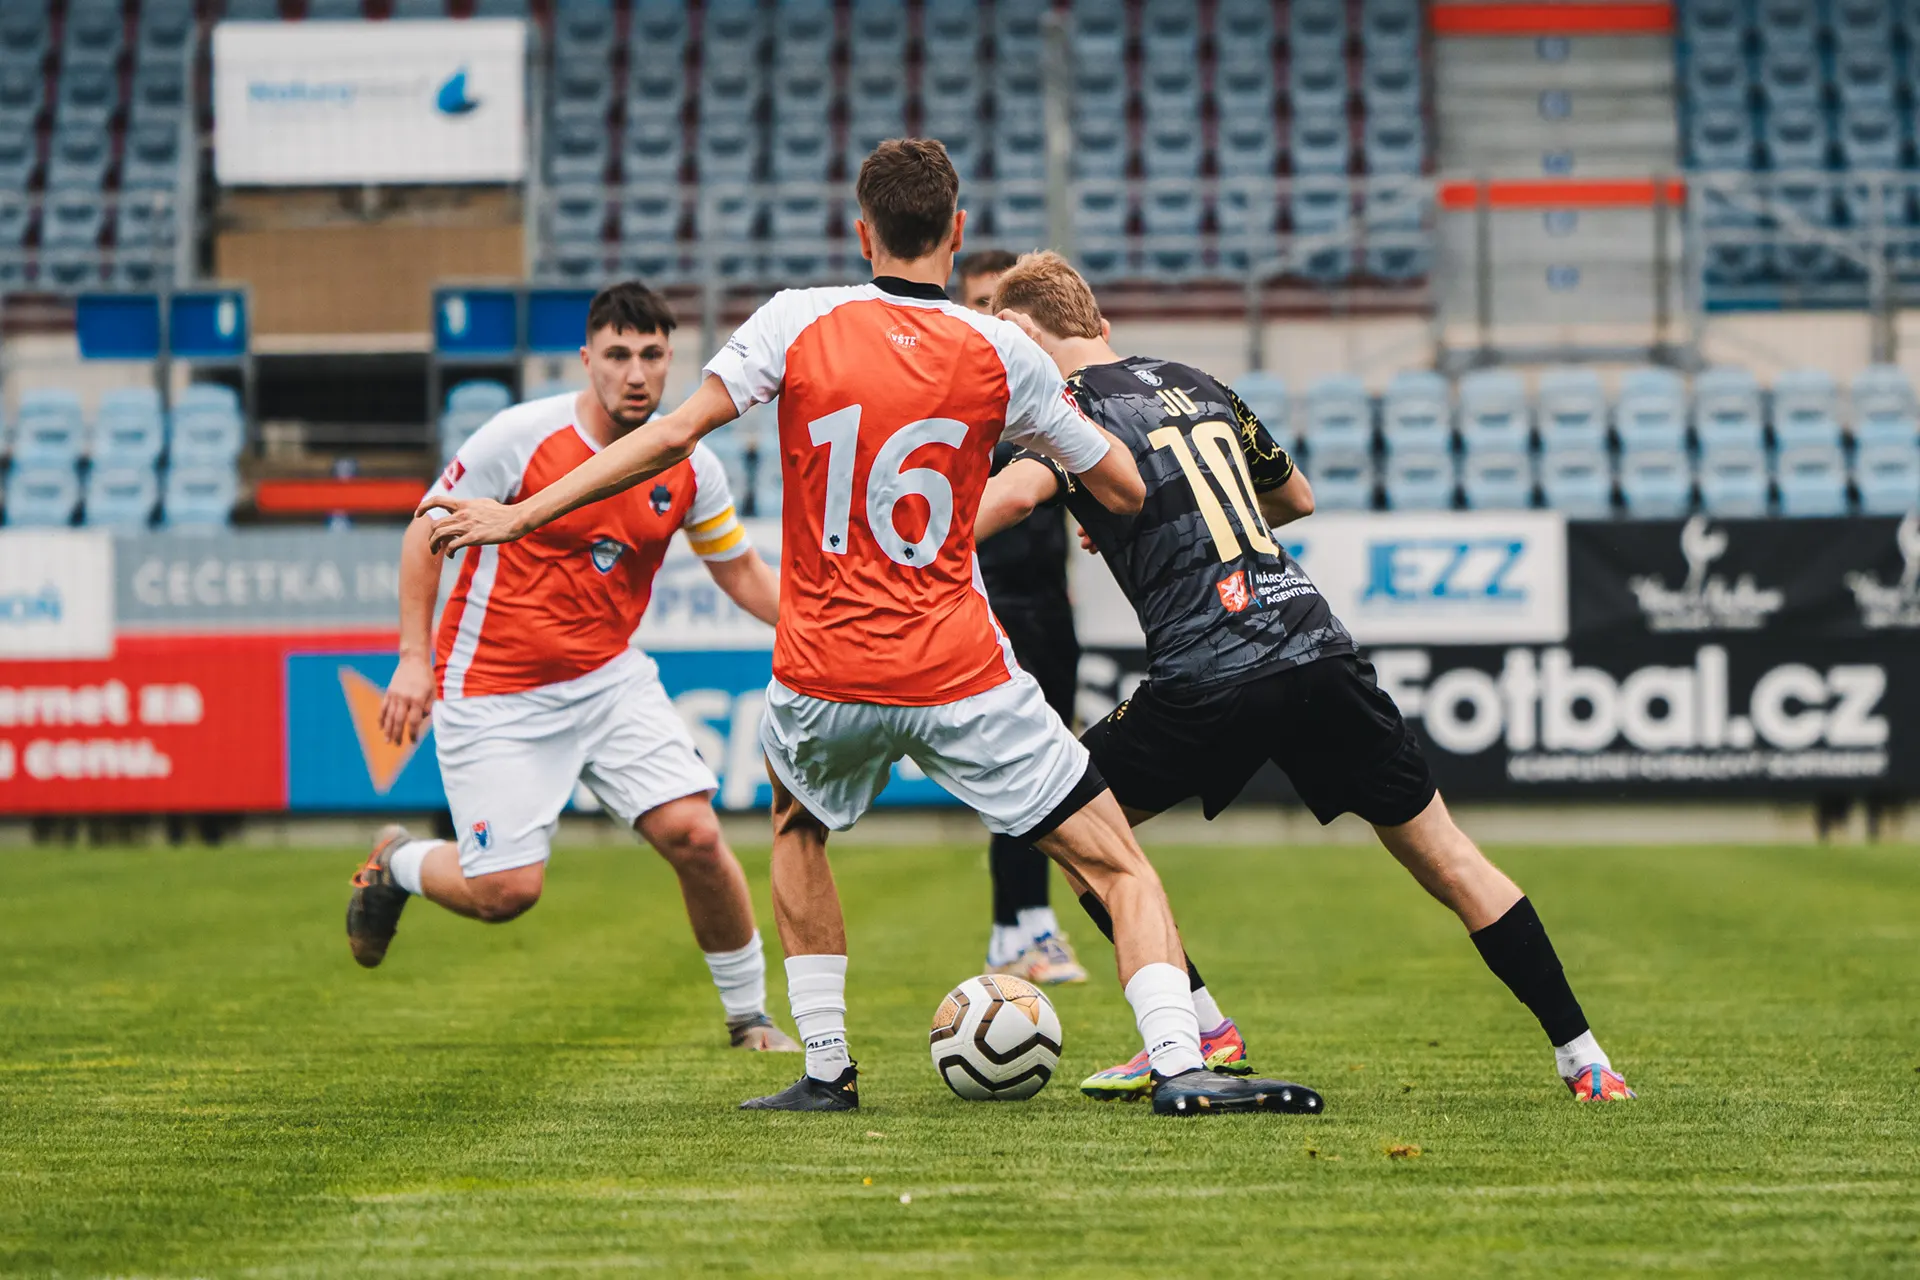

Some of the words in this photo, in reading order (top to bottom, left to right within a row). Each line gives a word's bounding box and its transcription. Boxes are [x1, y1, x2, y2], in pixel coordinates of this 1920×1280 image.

[891, 333, 917, 346] VŠTE
[1156, 387, 1198, 417] JU
[807, 403, 970, 569] 16
[1147, 421, 1280, 563] 10
[1362, 540, 1527, 602] JEZZ
[138, 683, 204, 726] za
[24, 737, 173, 780] cenu.
